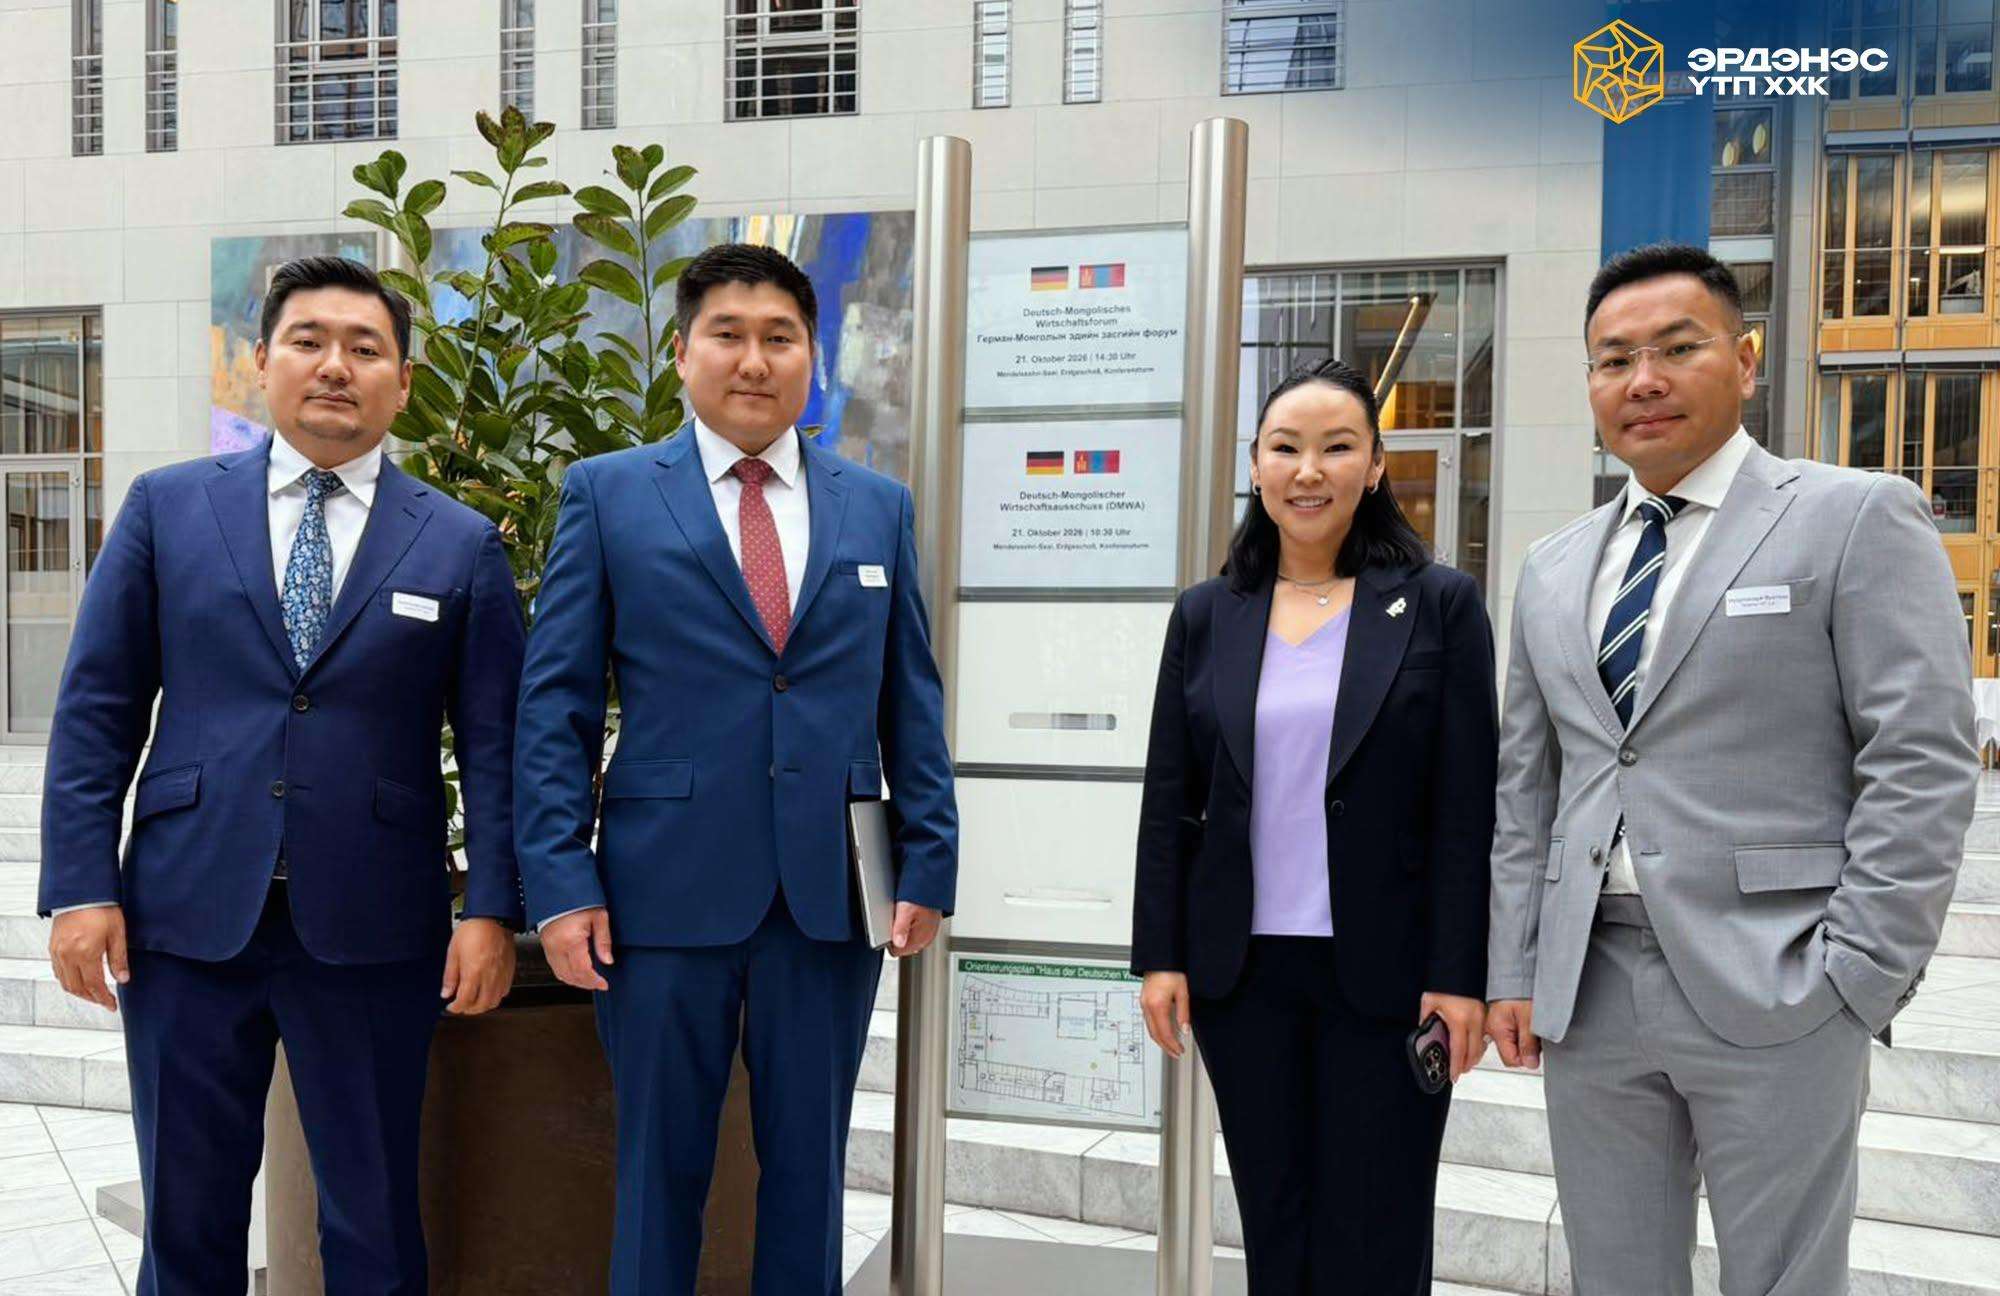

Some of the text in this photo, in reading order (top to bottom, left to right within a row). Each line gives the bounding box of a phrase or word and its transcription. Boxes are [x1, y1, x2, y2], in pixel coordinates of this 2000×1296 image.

[1022, 305, 1131, 317] Deutsch-Mongolisches
[1035, 318, 1118, 328] Wirtschaftsforum
[1142, 328, 1178, 339] форум
[1031, 354, 1066, 363] Oktober
[1120, 352, 1137, 360] Uhr
[1020, 490, 1126, 501] Deutsch-Mongolischer
[1000, 501, 1146, 512] Wirtschaftsausschuss (DMWA)
[1027, 528, 1061, 537] Oktober
[1115, 528, 1132, 536] Uhr
[1062, 966, 1076, 977] der
[1077, 967, 1121, 980] Deutschen
